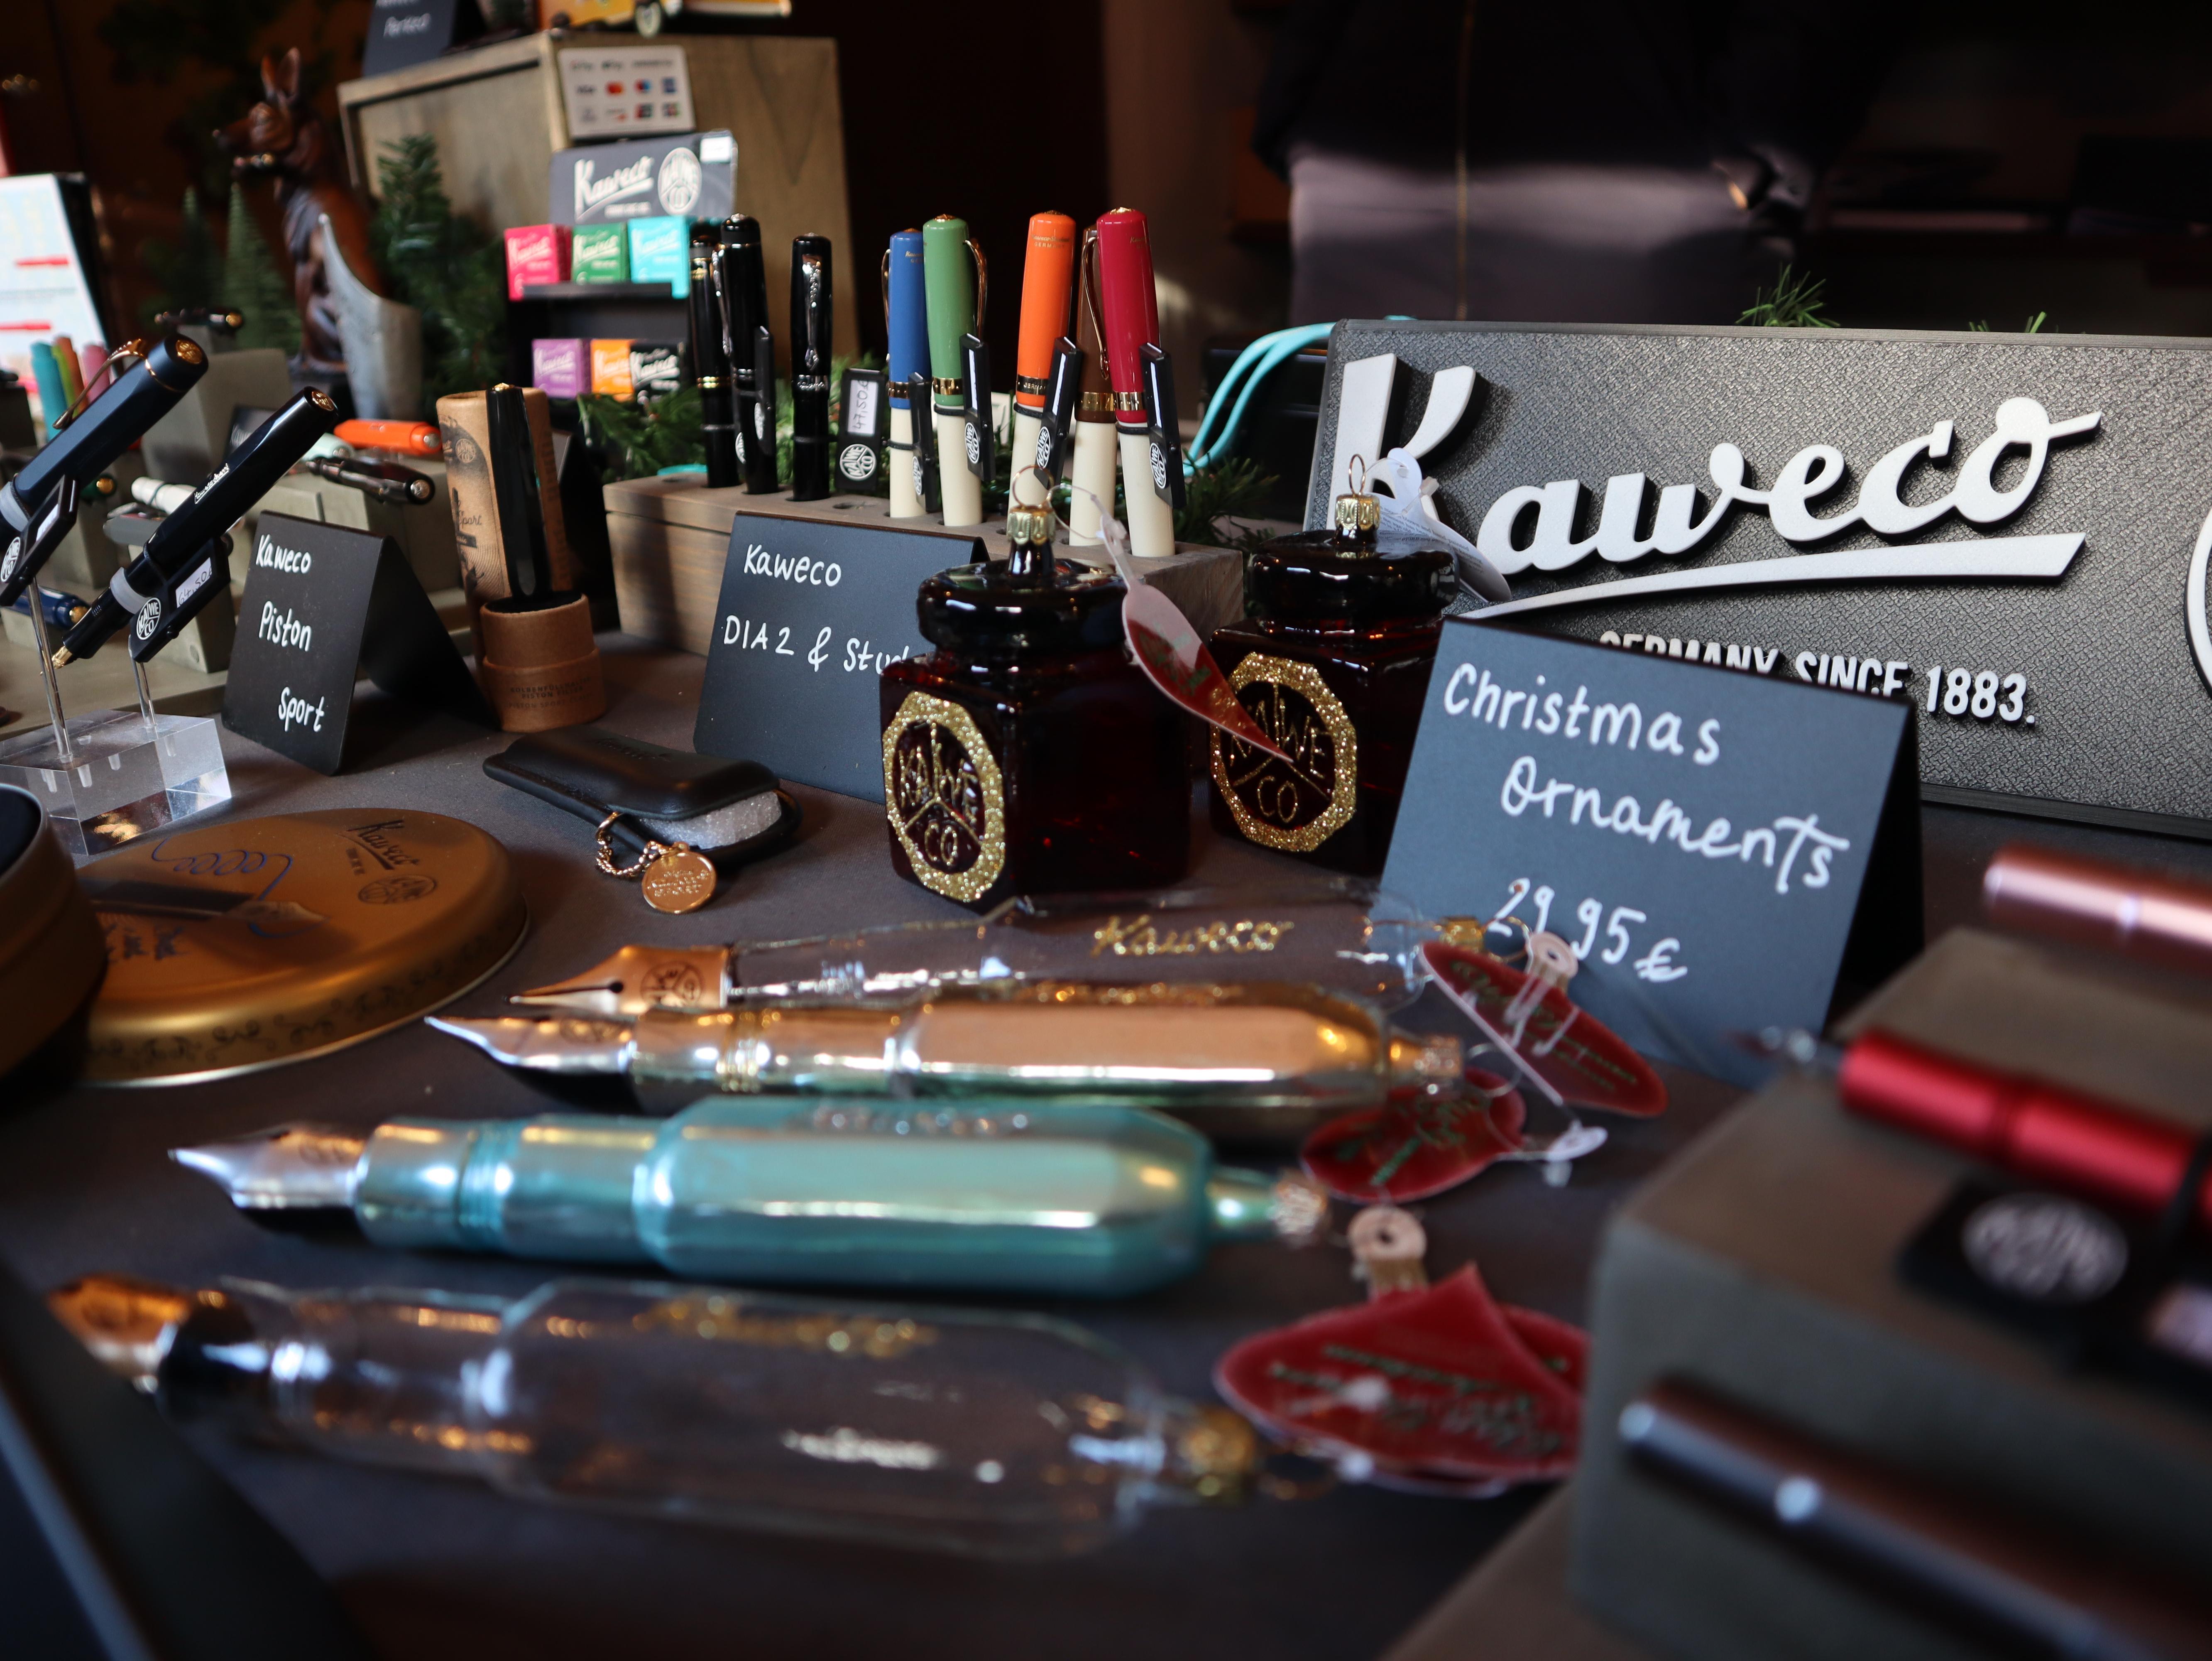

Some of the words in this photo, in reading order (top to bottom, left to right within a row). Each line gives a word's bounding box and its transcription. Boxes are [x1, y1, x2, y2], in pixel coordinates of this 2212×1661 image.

[575, 156, 655, 220] Kaweco
[1327, 353, 2103, 581] Kaweco
[256, 534, 311, 573] Kaweco
[744, 544, 842, 586] Kaweco
[259, 600, 311, 652] Piston
[807, 626, 832, 672] &
[278, 686, 325, 732] Sport
[1444, 663, 1721, 765] Christmas
[1926, 664, 2036, 727] 1883.
[1500, 755, 1850, 894] Ornaments
[1090, 915, 1295, 958] Kaweco
